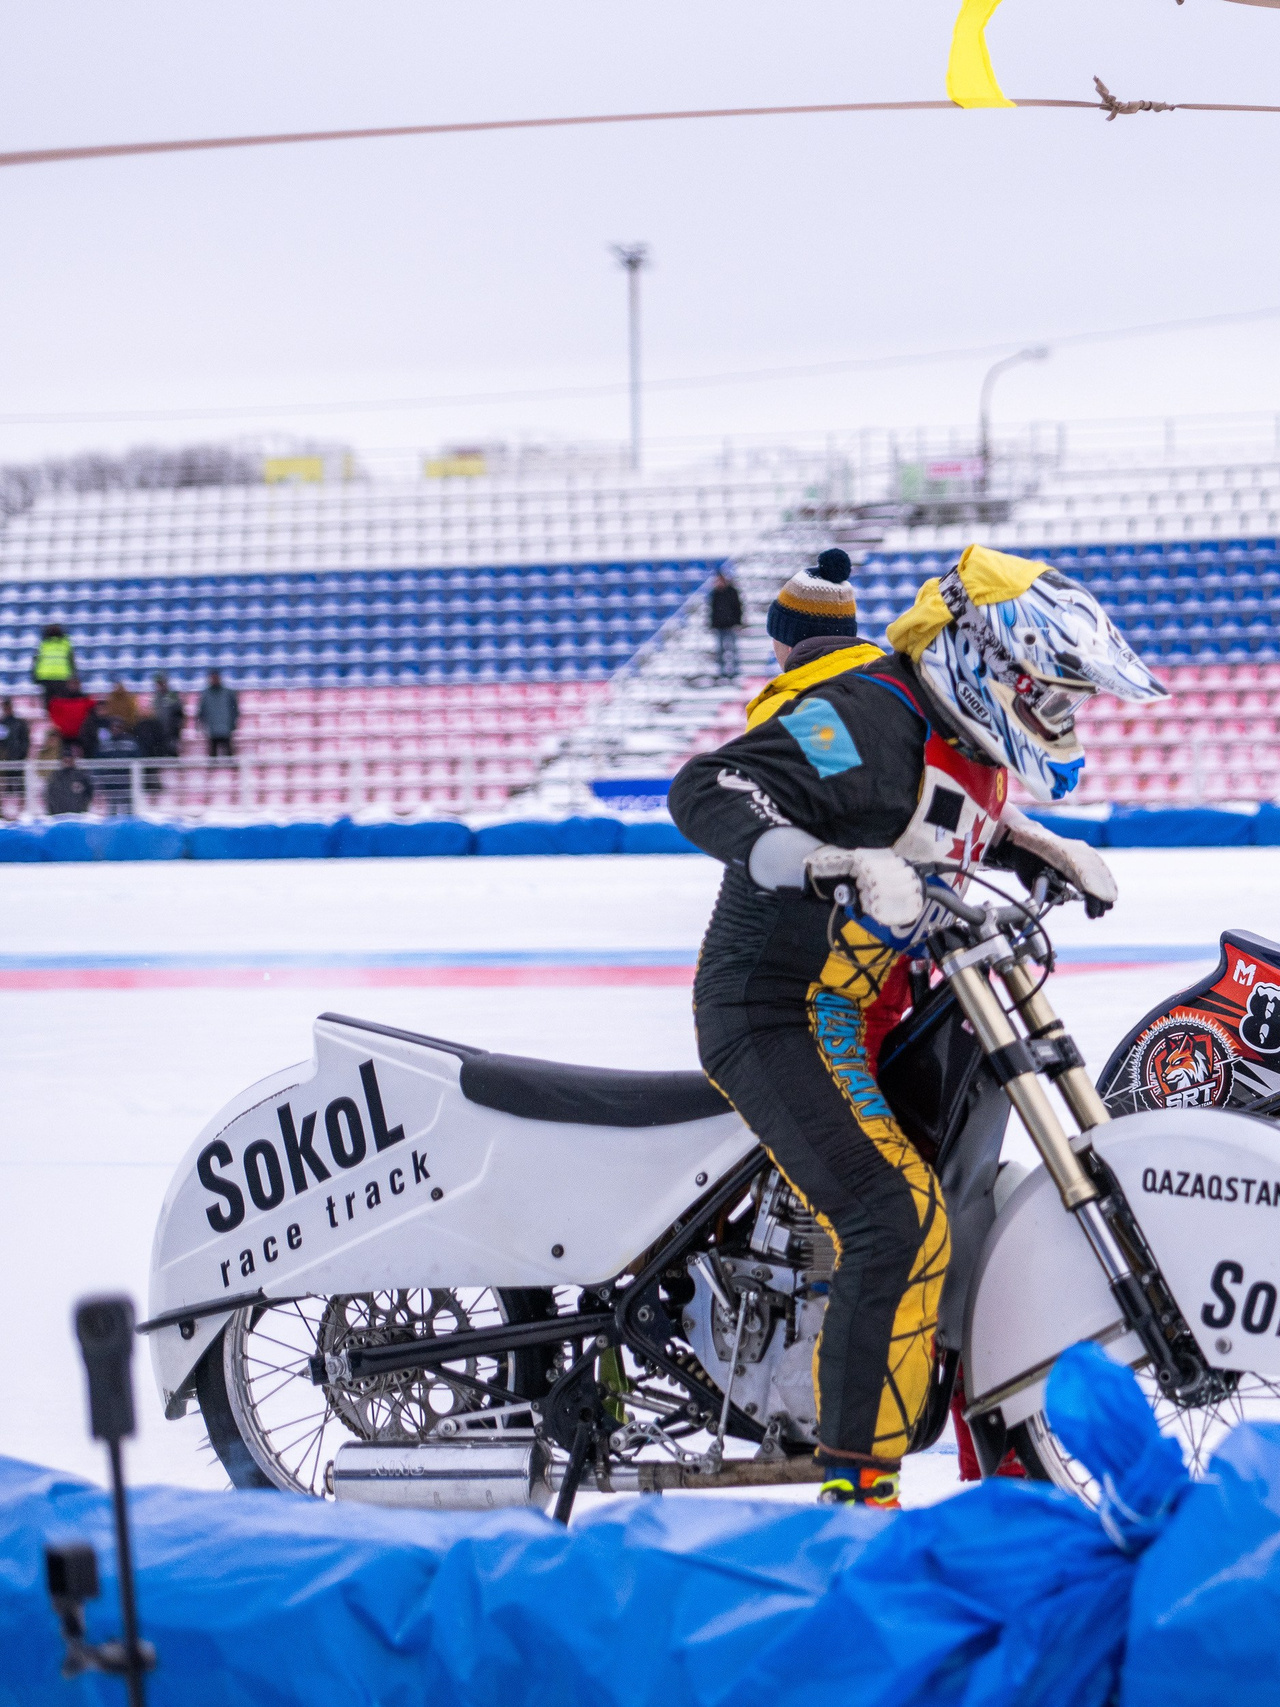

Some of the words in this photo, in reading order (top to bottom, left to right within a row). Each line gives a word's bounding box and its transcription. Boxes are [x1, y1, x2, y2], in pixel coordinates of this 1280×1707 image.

[959, 685, 989, 719] SHOEI
[1165, 1081, 1217, 1109] SRT
[220, 1220, 303, 1288] race
[326, 1149, 432, 1230] track
